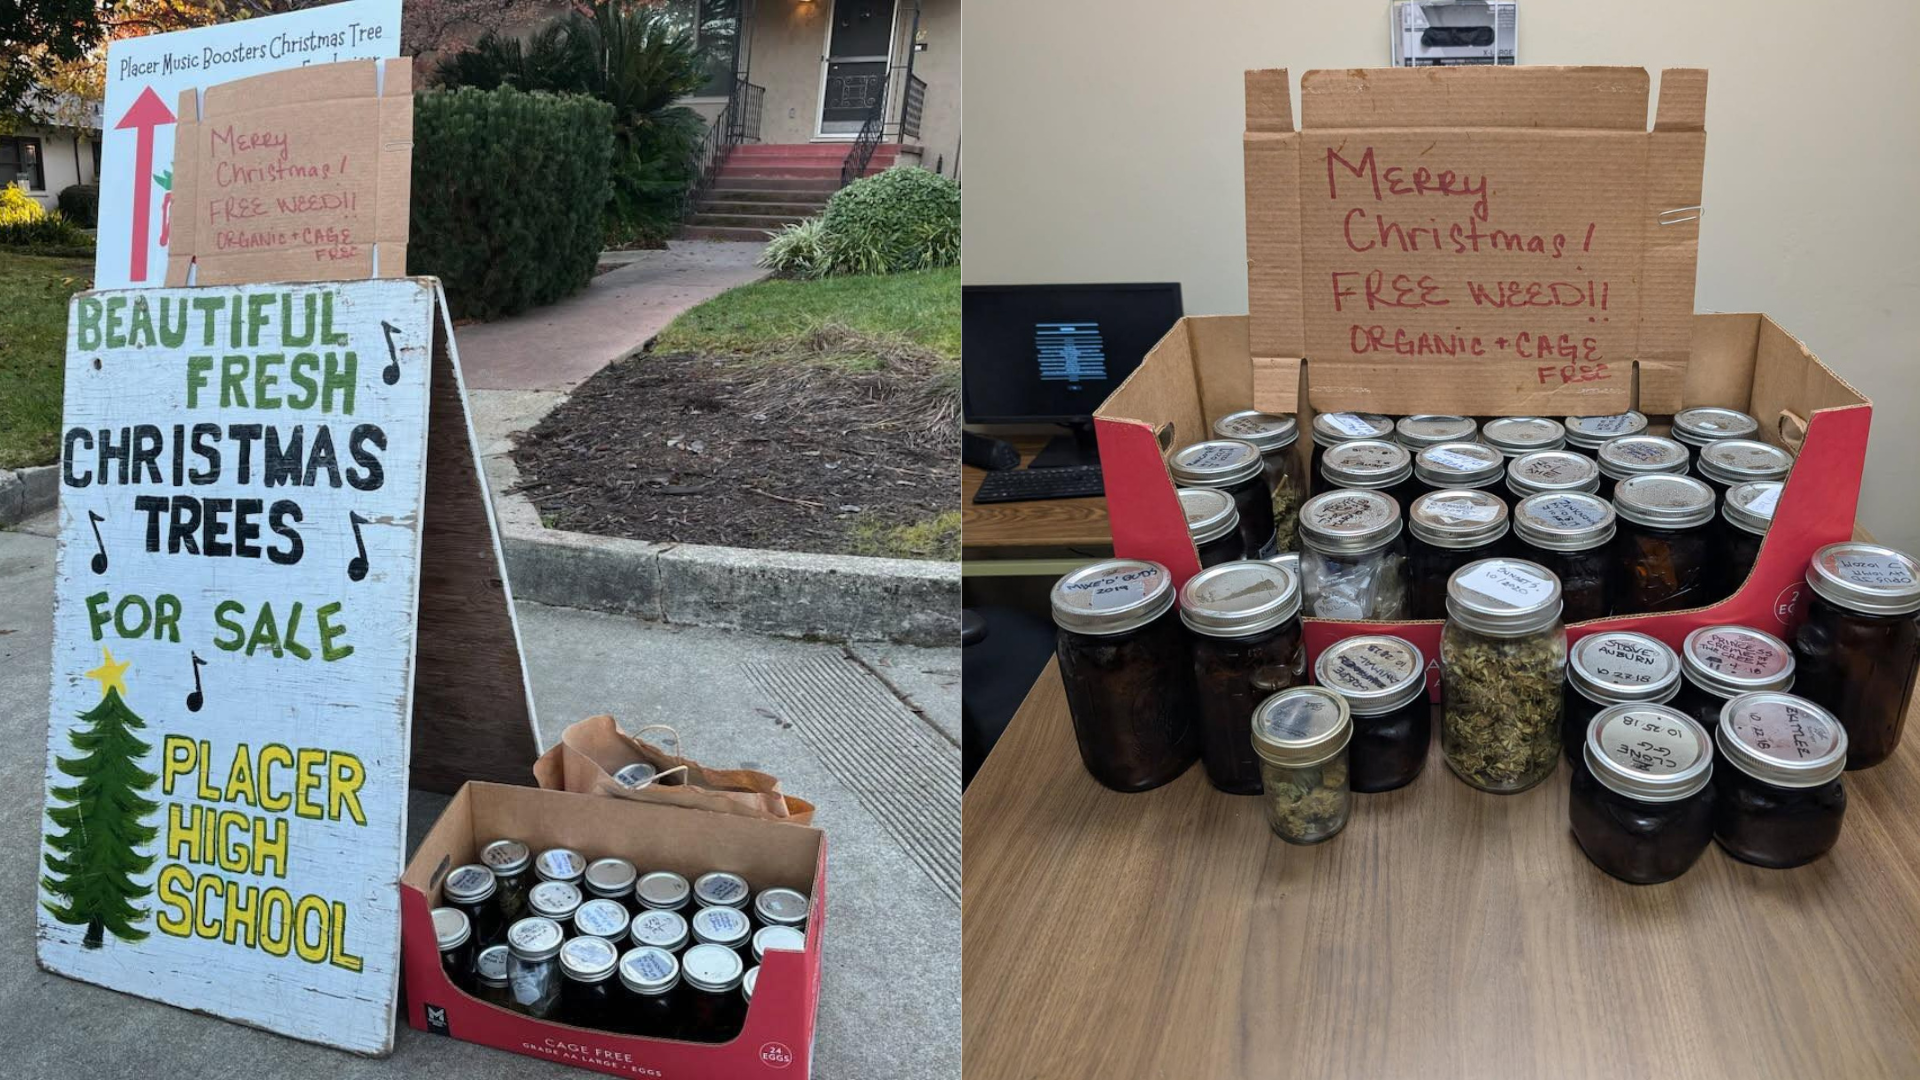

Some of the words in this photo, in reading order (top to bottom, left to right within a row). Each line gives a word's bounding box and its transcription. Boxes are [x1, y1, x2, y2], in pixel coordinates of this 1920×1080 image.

[120, 56, 160, 81] Placer
[162, 53, 199, 75] Music
[203, 42, 267, 69] Boosters
[270, 31, 345, 59] Christmas
[348, 23, 382, 46] Tree
[210, 196, 268, 225] FREE
[277, 191, 357, 219] WEED!!
[302, 227, 353, 246] CAGE
[314, 246, 358, 261] FREE
[1332, 269, 1450, 312] FREE
[1467, 279, 1609, 322] WEED!!
[77, 291, 349, 351] BEAUTIFUL
[1515, 331, 1604, 364] CAGE
[186, 351, 358, 415] FRESH
[1538, 363, 1612, 384] FREE
[63, 422, 387, 491] CHRISTMAS
[135, 495, 304, 565] TREES
[85, 591, 182, 643] FOR
[213, 600, 354, 662] SALE
[1599, 646, 1655, 665] AUBURN
[1616, 744, 1677, 768] CLONE
[162, 734, 367, 826] PLACER
[167, 802, 289, 879] HIGH
[156, 863, 364, 974] SCHOOL
[522, 1042, 558, 1055] GRADE
[563, 1052, 578, 1060] AA
[582, 1056, 618, 1068] LARGE
[631, 1065, 662, 1077] EGGS
[544, 1038, 589, 1054] CAGE
[595, 1048, 633, 1063] FREE
[762, 1052, 790, 1062] EGGS
[770, 1046, 782, 1054] 24
